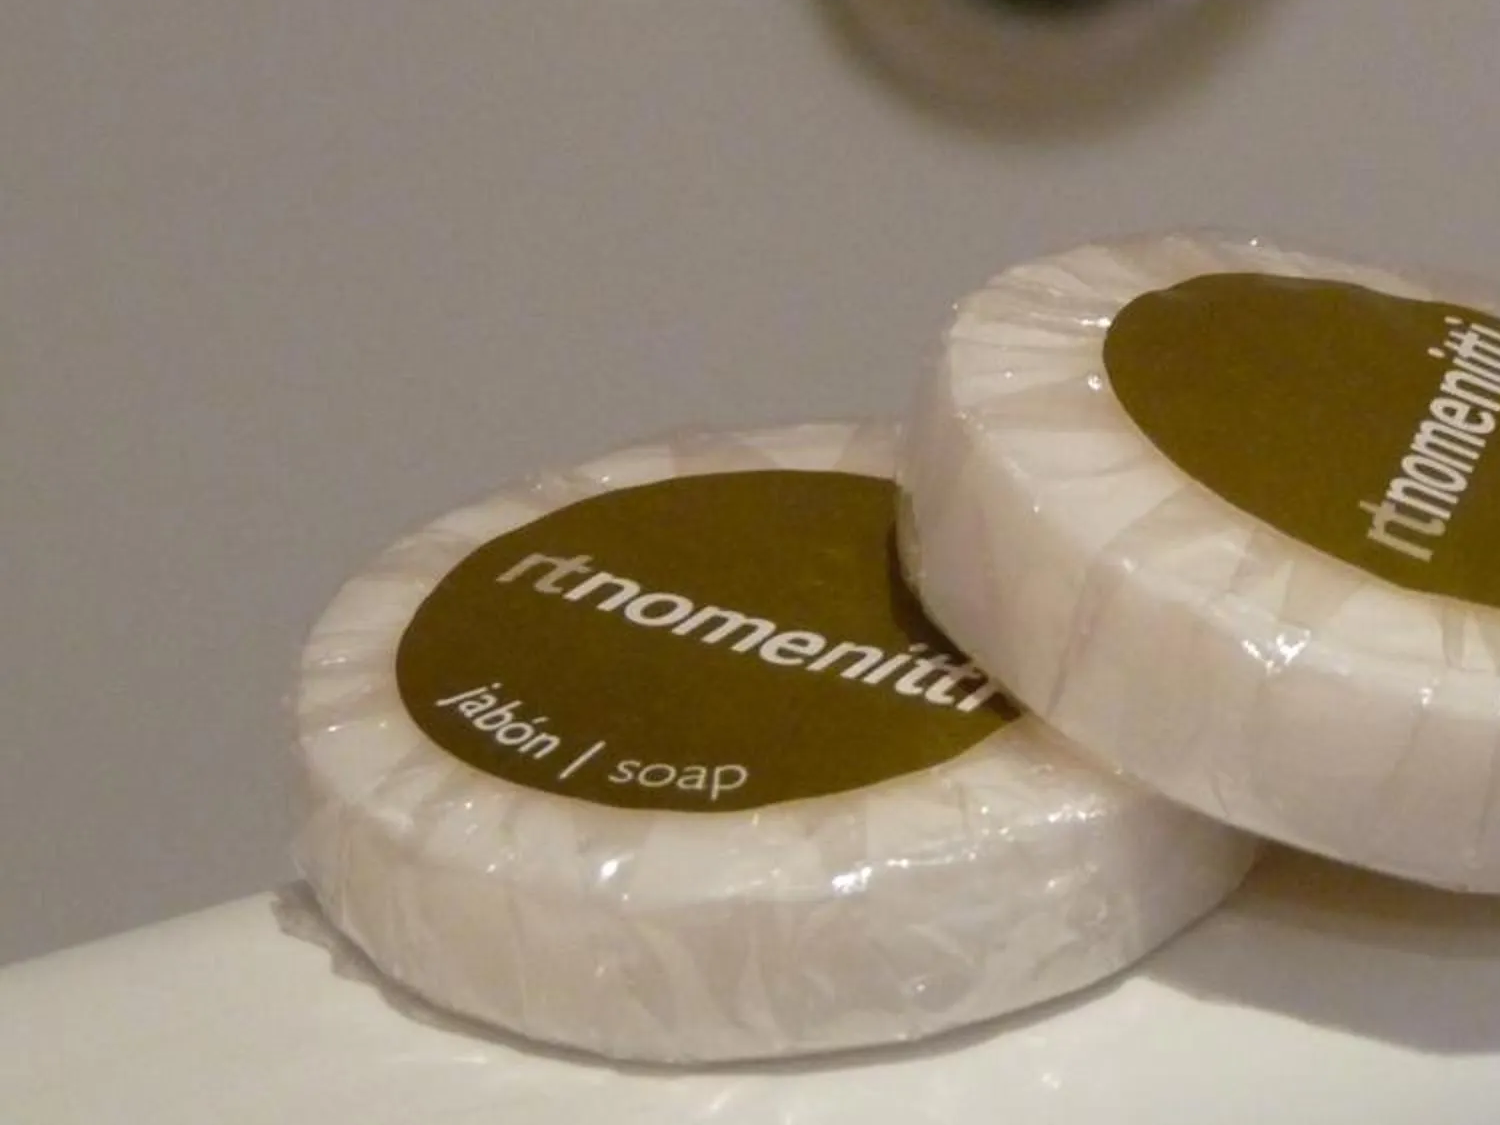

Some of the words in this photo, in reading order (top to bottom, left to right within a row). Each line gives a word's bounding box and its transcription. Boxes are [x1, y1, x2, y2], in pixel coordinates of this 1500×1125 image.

[497, 551, 999, 713] rtnomenitti
[436, 682, 559, 759] jabón
[607, 758, 749, 801] soap
